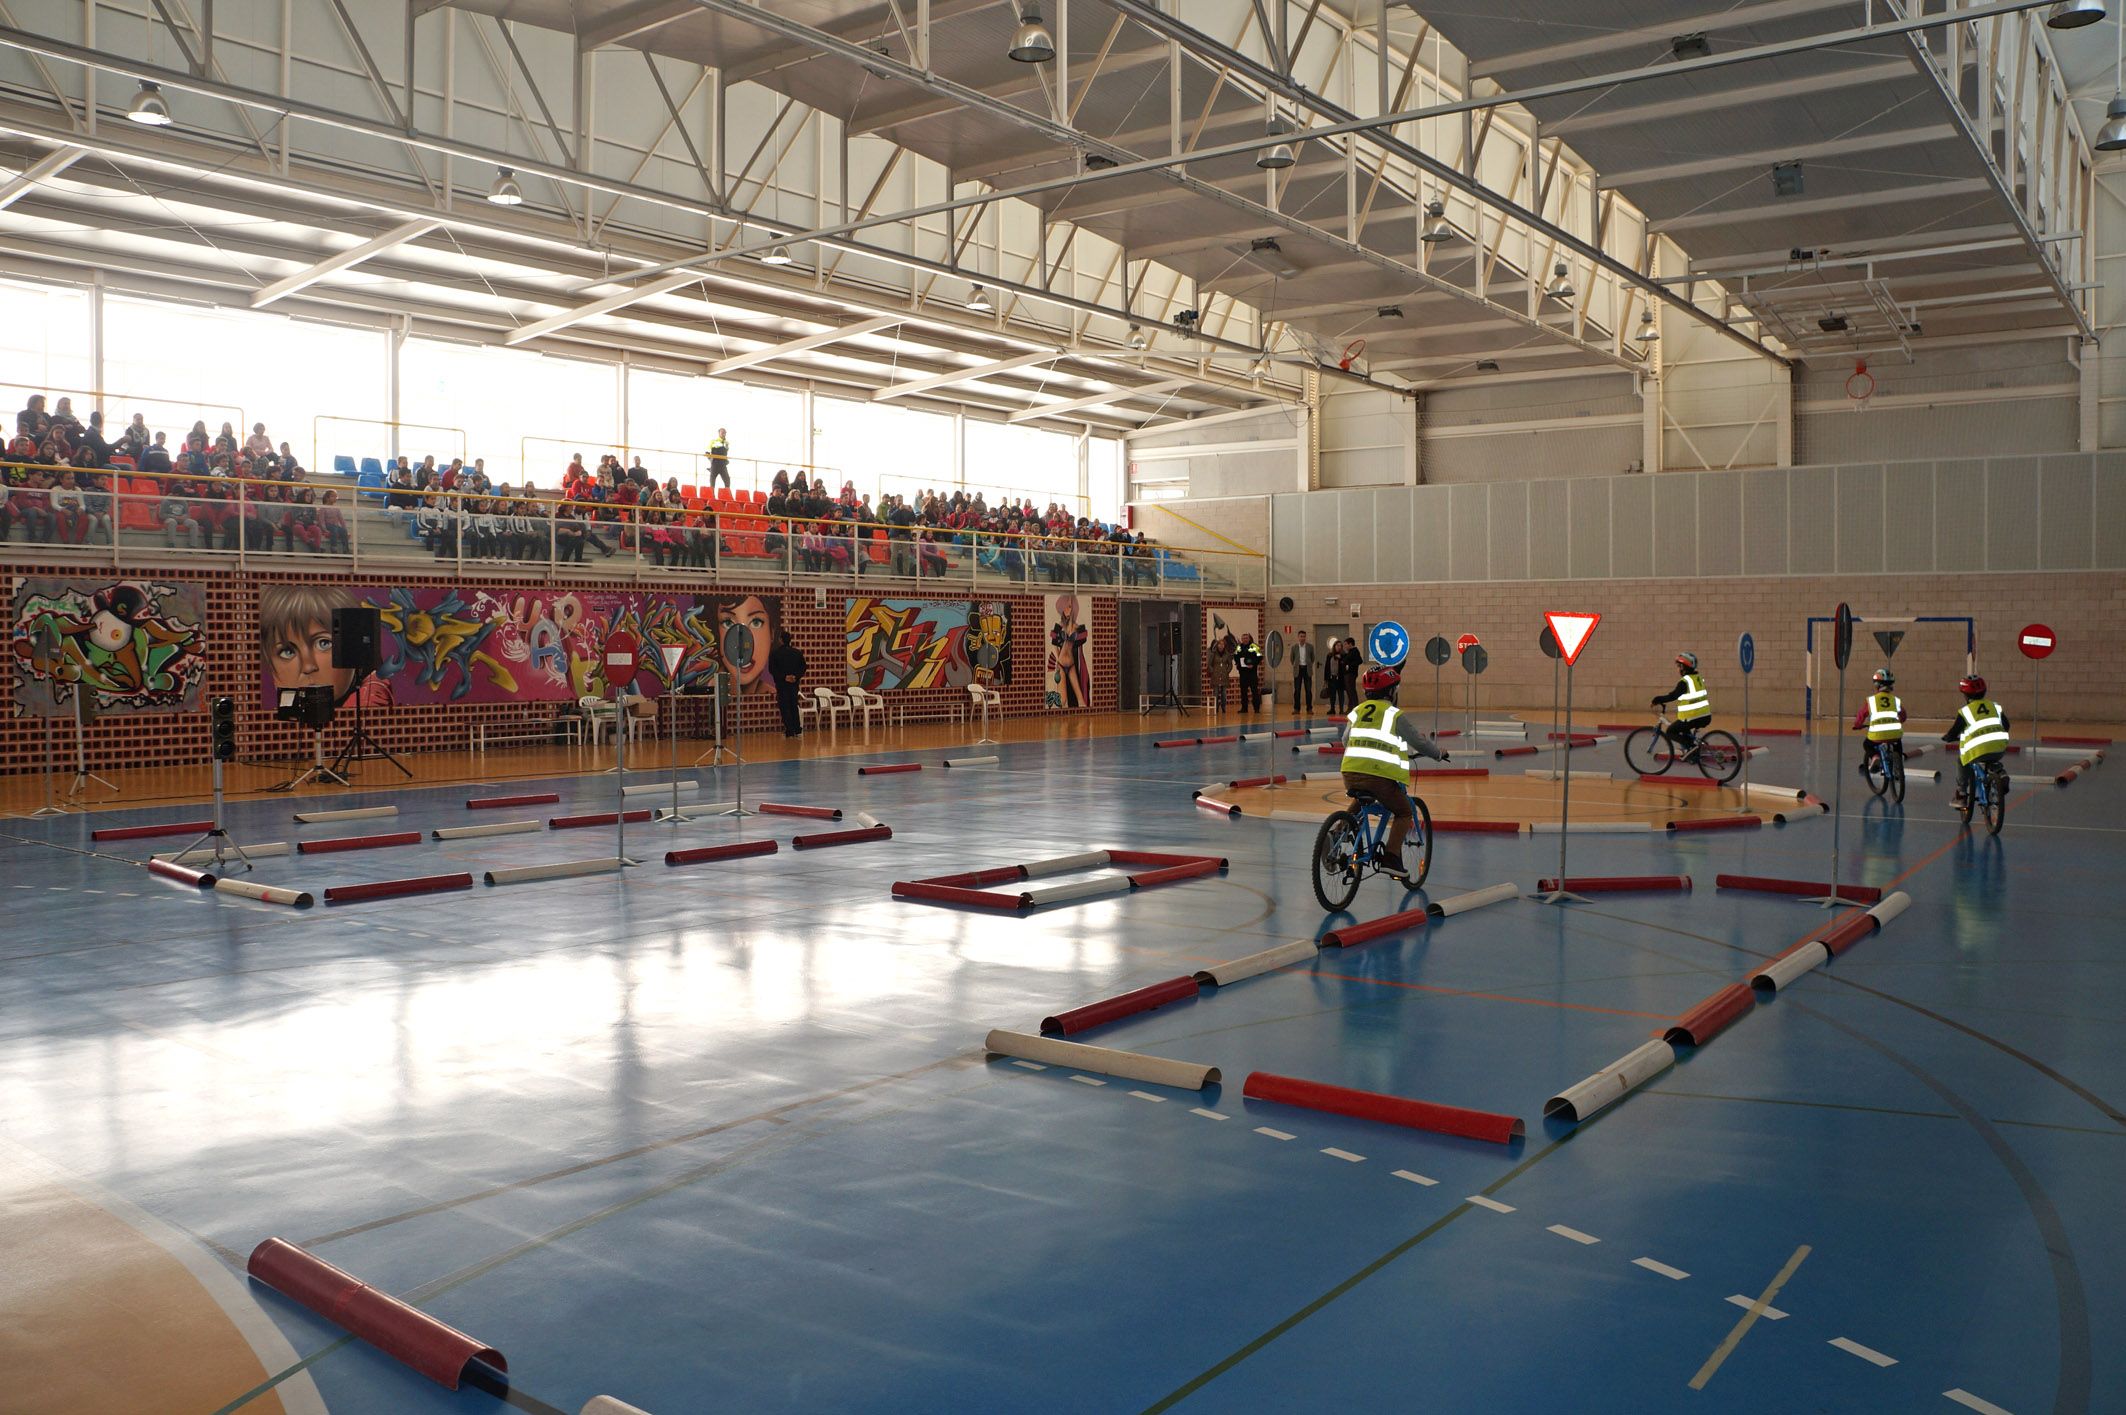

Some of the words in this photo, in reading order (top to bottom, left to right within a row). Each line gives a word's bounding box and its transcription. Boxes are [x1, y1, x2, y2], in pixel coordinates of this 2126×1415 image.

[1880, 696, 1891, 708] 3
[1361, 703, 1377, 723] 2
[1976, 703, 1990, 715] 4
